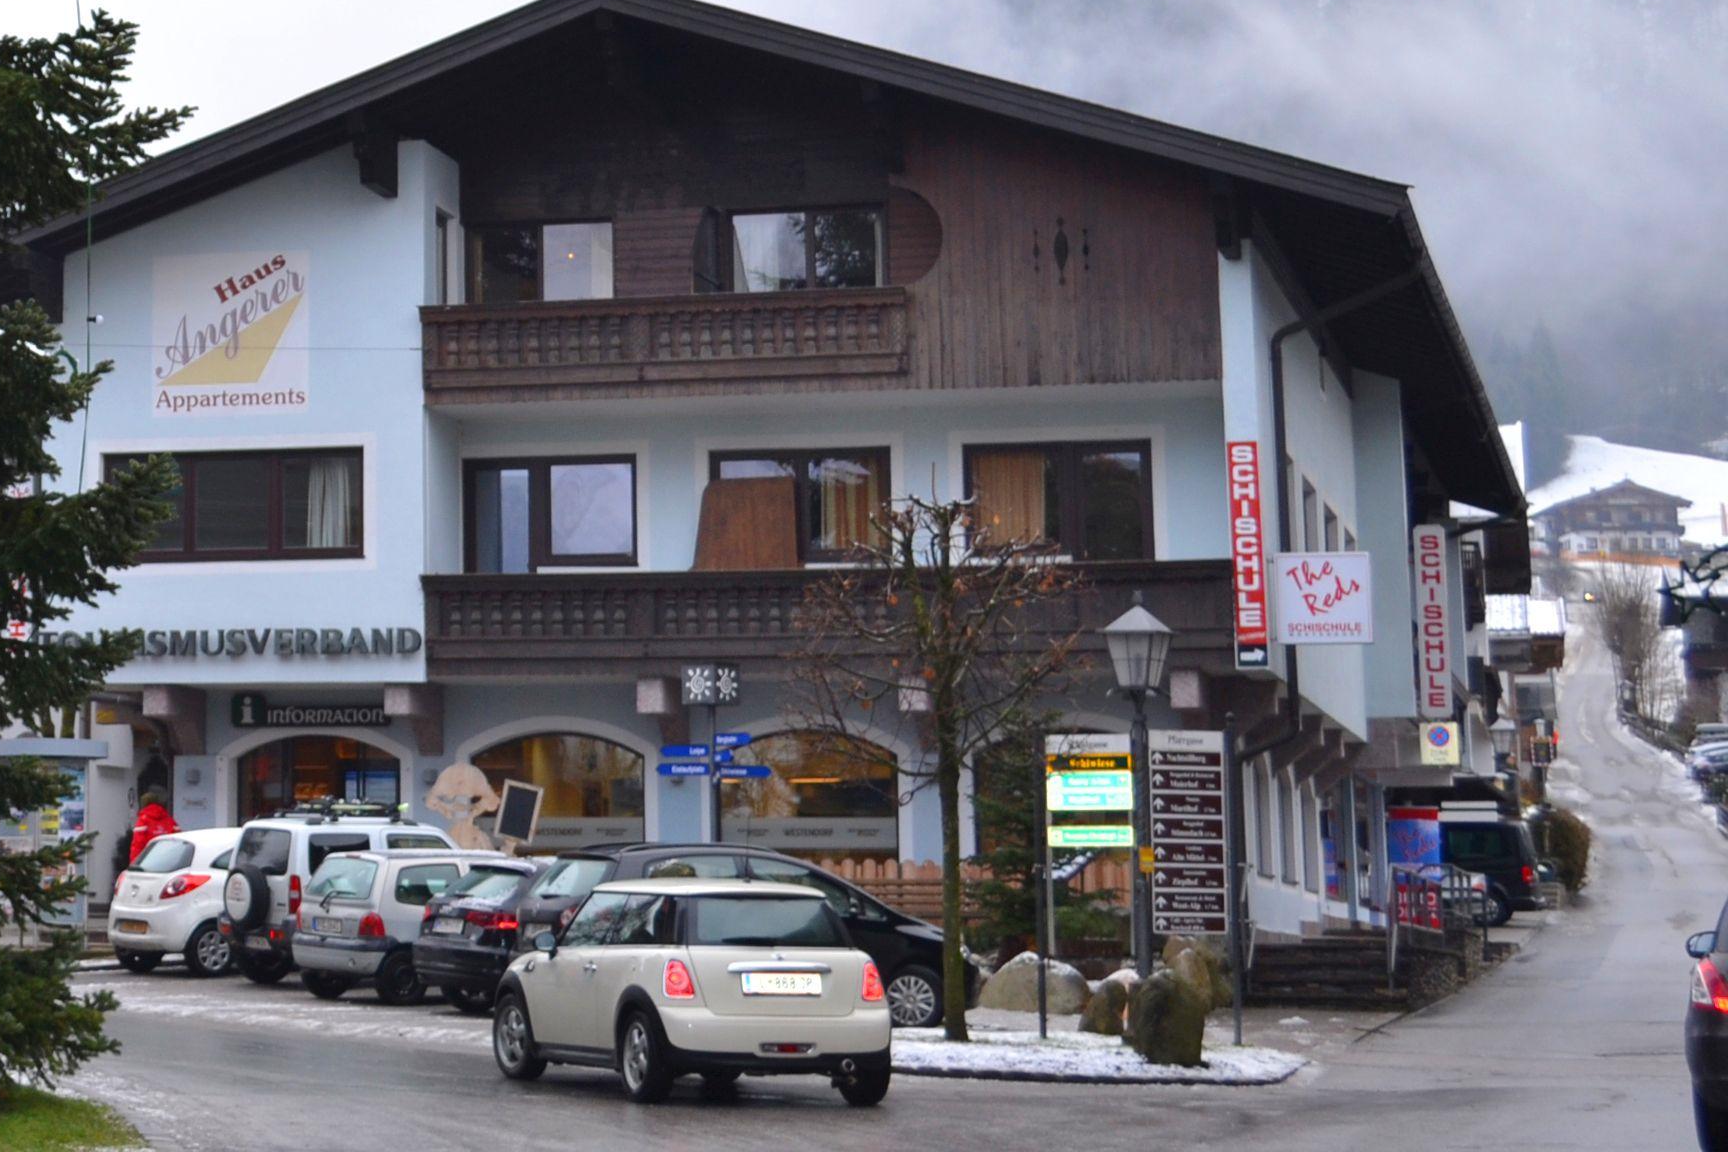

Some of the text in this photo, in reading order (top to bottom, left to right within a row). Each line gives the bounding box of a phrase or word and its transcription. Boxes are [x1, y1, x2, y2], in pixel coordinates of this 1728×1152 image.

[214, 254, 286, 303] Haus
[155, 269, 305, 379] Angerer
[156, 388, 306, 412] Appartements
[1231, 445, 1262, 628] SCHISCHULE
[1285, 560, 1333, 591] The
[1302, 575, 1360, 616] Reds
[1287, 622, 1362, 633] SCHISCHULE
[1420, 535, 1445, 708] SCHISCHULE
